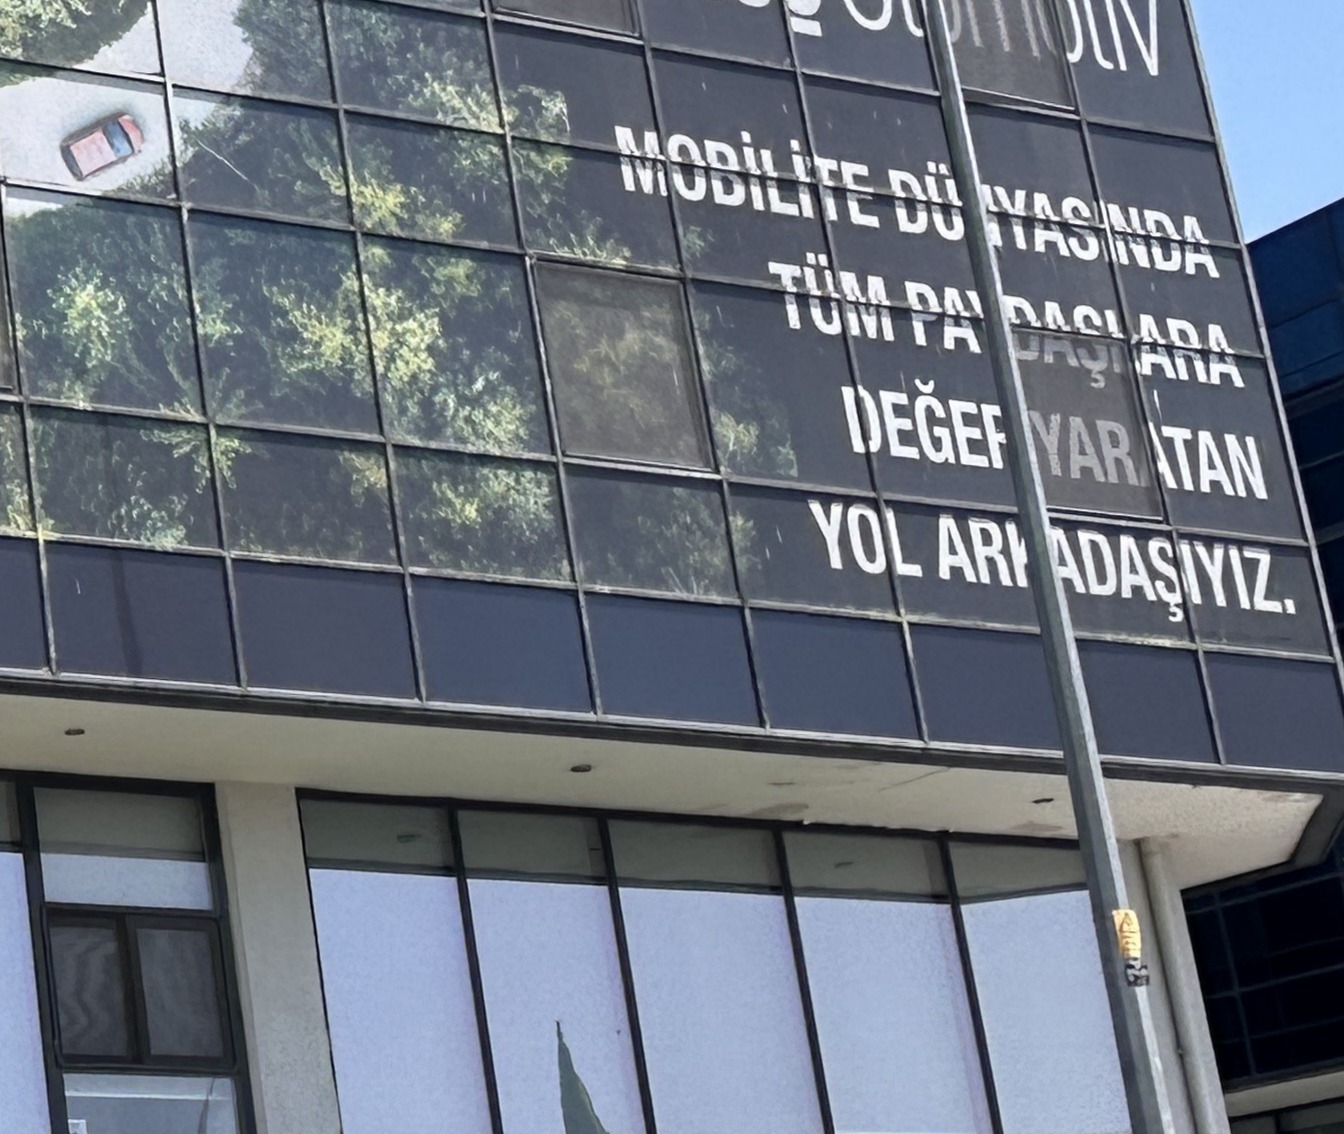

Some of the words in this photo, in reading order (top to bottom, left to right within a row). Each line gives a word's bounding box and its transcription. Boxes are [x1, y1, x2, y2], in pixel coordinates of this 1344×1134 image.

[614, 125, 880, 228] MOBİLİTE
[768, 253, 895, 342] TÜM
[904, 281, 1246, 389] PADAŞLARA
[808, 499, 923, 578] YOL
